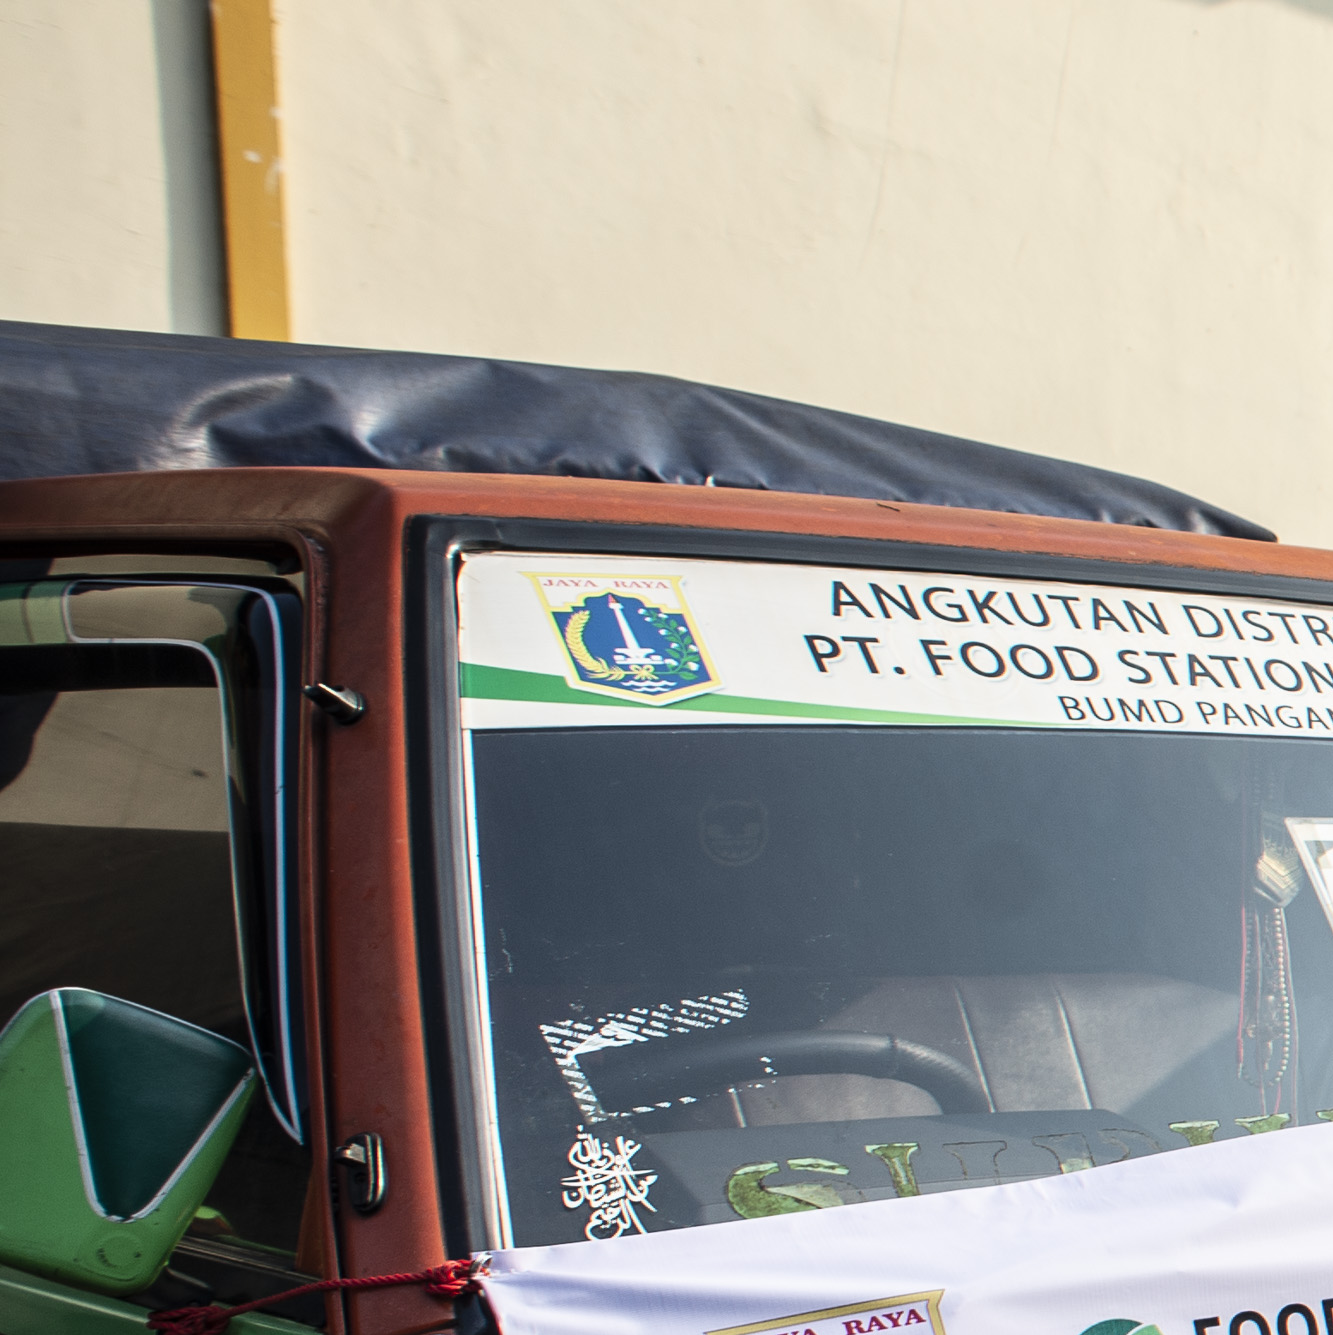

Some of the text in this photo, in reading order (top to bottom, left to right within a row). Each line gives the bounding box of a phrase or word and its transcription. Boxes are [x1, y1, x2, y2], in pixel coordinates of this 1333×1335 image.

[541, 576, 670, 591] JAYA RAYA
[831, 580, 1166, 636] ANGKUTAN
[803, 634, 905, 677] PT.
[919, 638, 1100, 683] FOOD
[1058, 695, 1184, 726] BUMD
